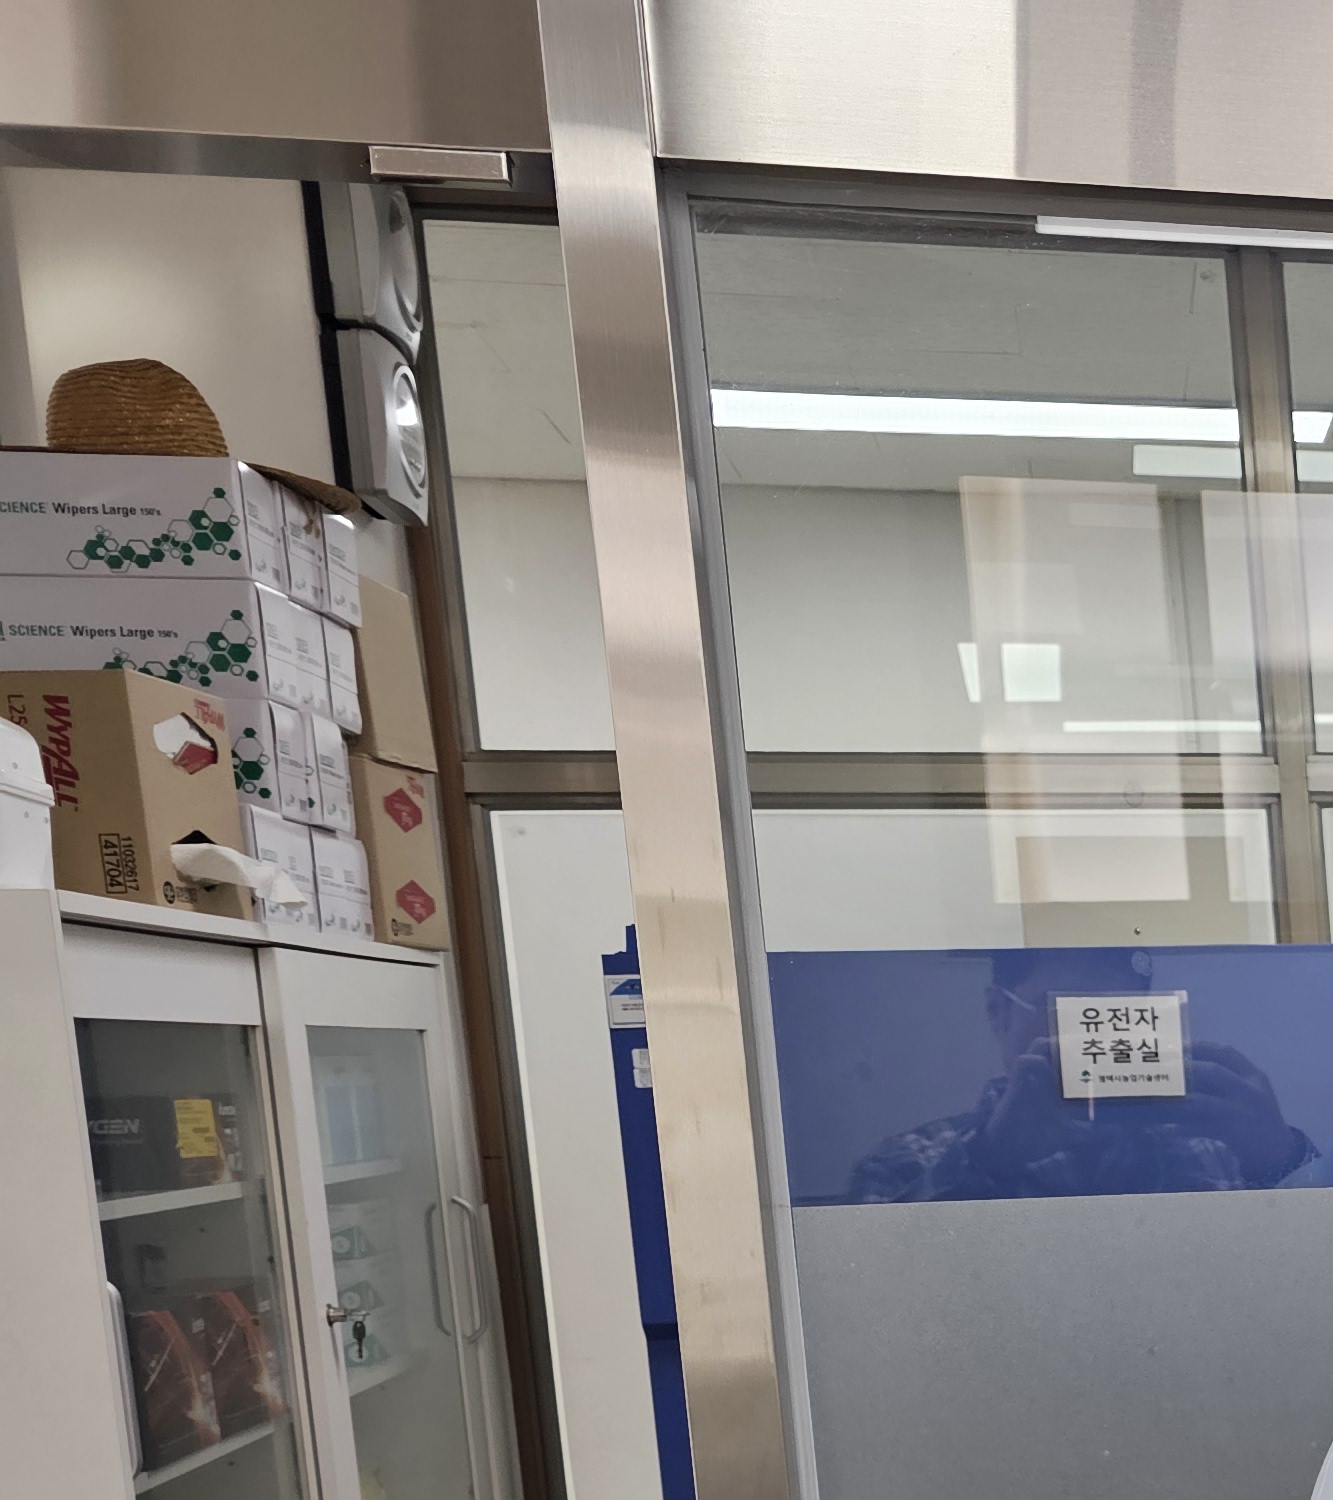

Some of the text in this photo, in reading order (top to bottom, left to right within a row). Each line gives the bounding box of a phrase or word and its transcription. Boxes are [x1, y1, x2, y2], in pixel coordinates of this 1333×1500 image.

[52, 502, 98, 516] Wipers
[102, 504, 136, 517] Large
[8, 624, 65, 636] SCIENCE
[70, 625, 116, 640] Wipers
[120, 626, 154, 640] Large
[104, 840, 122, 888] 41704
[122, 836, 140, 892] 11032617
[1080, 1007, 1159, 1032] 유전자
[1082, 1038, 1160, 1064] 추출실
